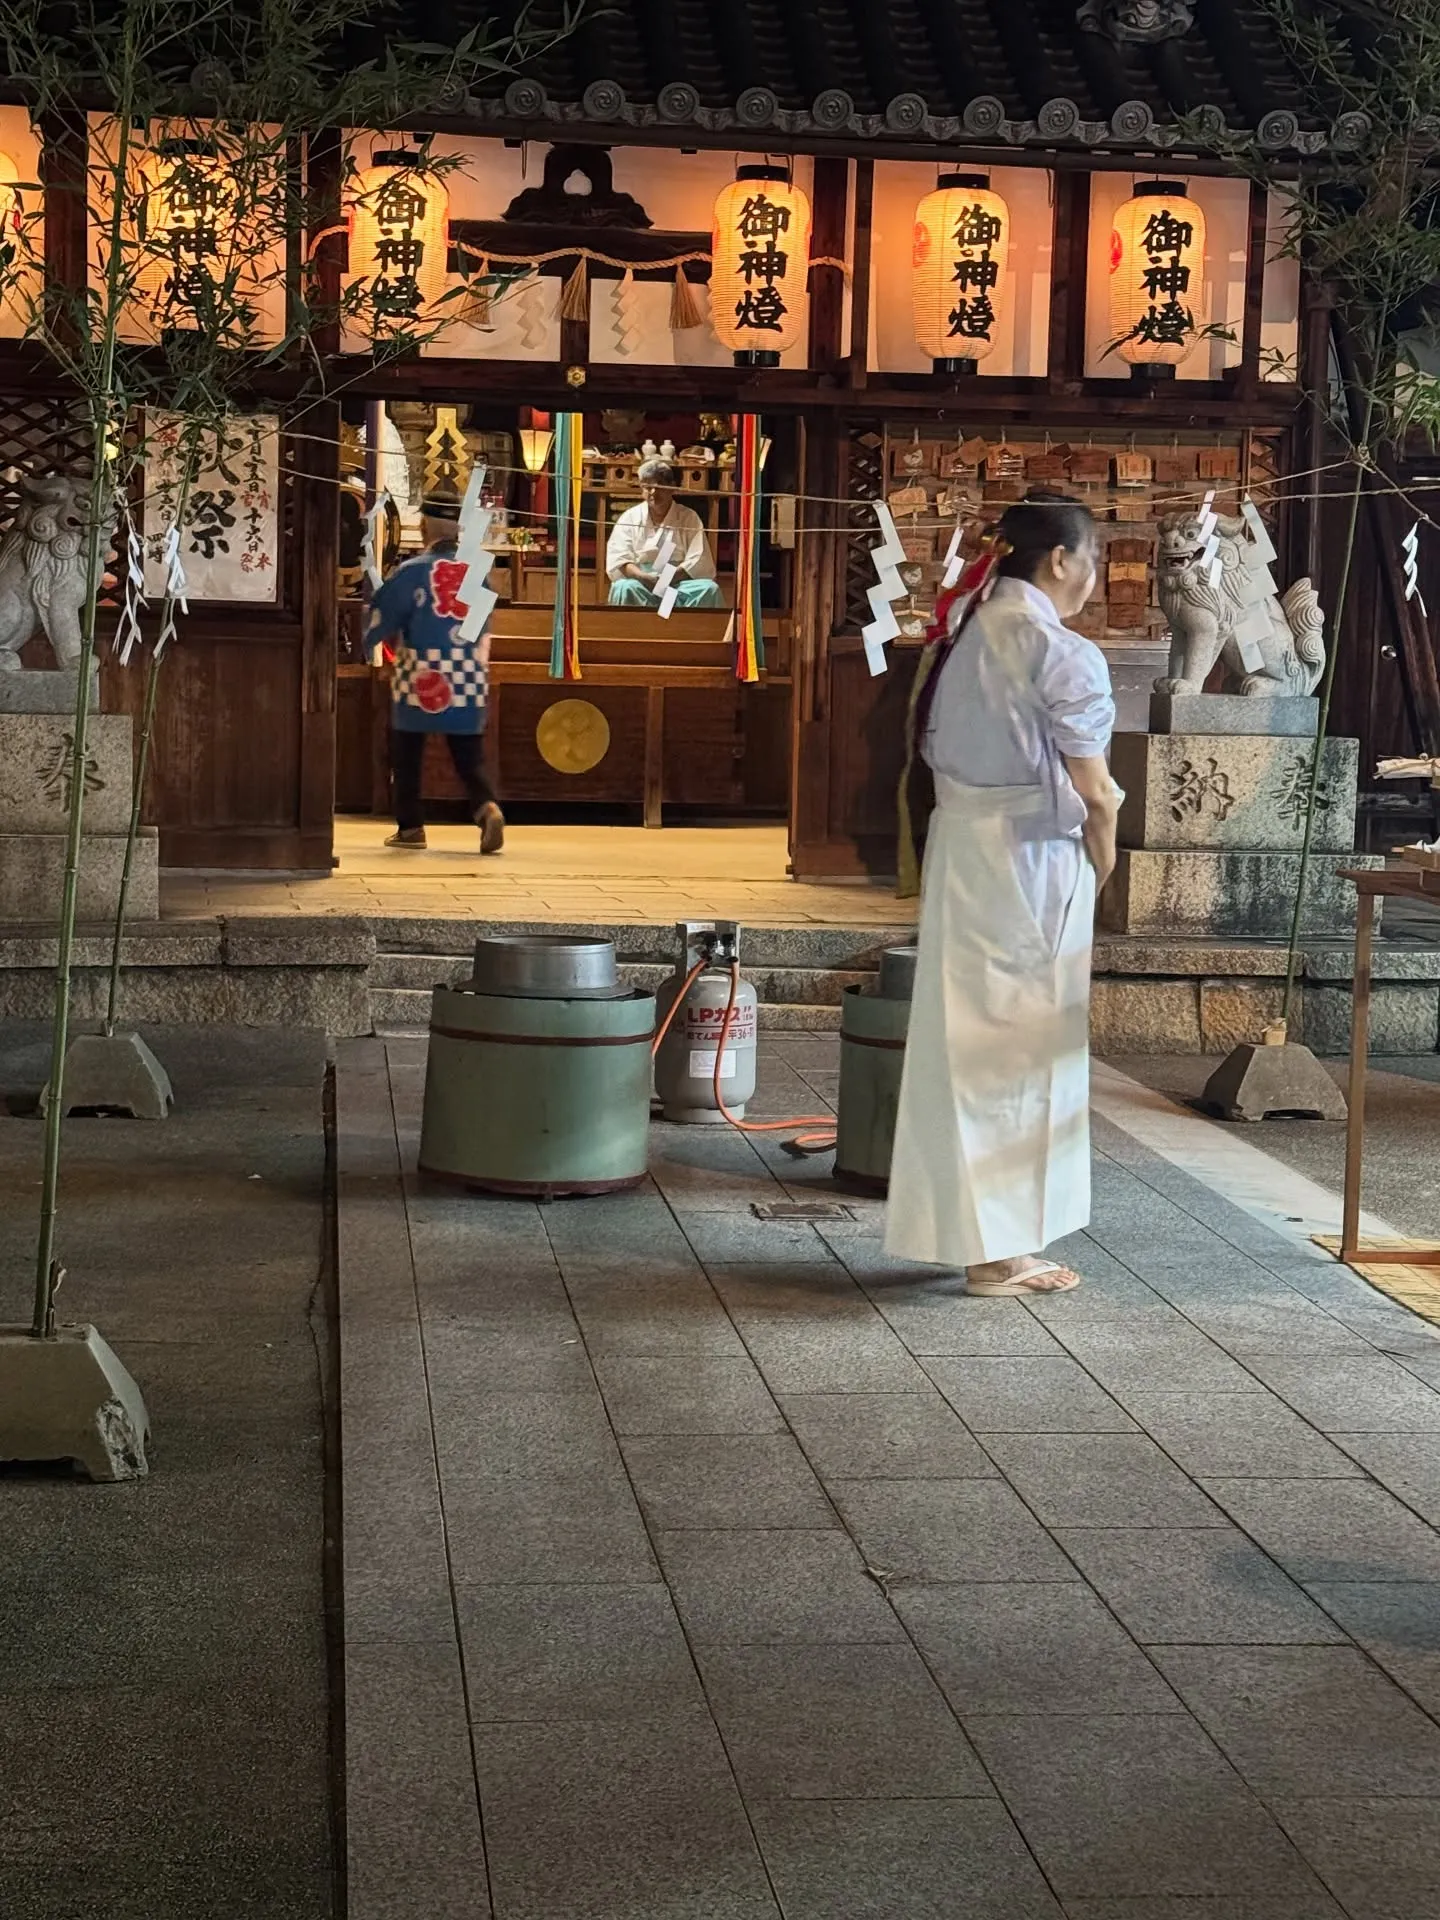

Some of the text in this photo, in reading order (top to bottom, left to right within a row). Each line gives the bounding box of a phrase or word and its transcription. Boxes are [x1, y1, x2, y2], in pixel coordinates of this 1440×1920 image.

[735, 193, 791, 332] 御神燈
[948, 204, 1002, 342] 御神燈
[1137, 210, 1193, 344] 御神燈
